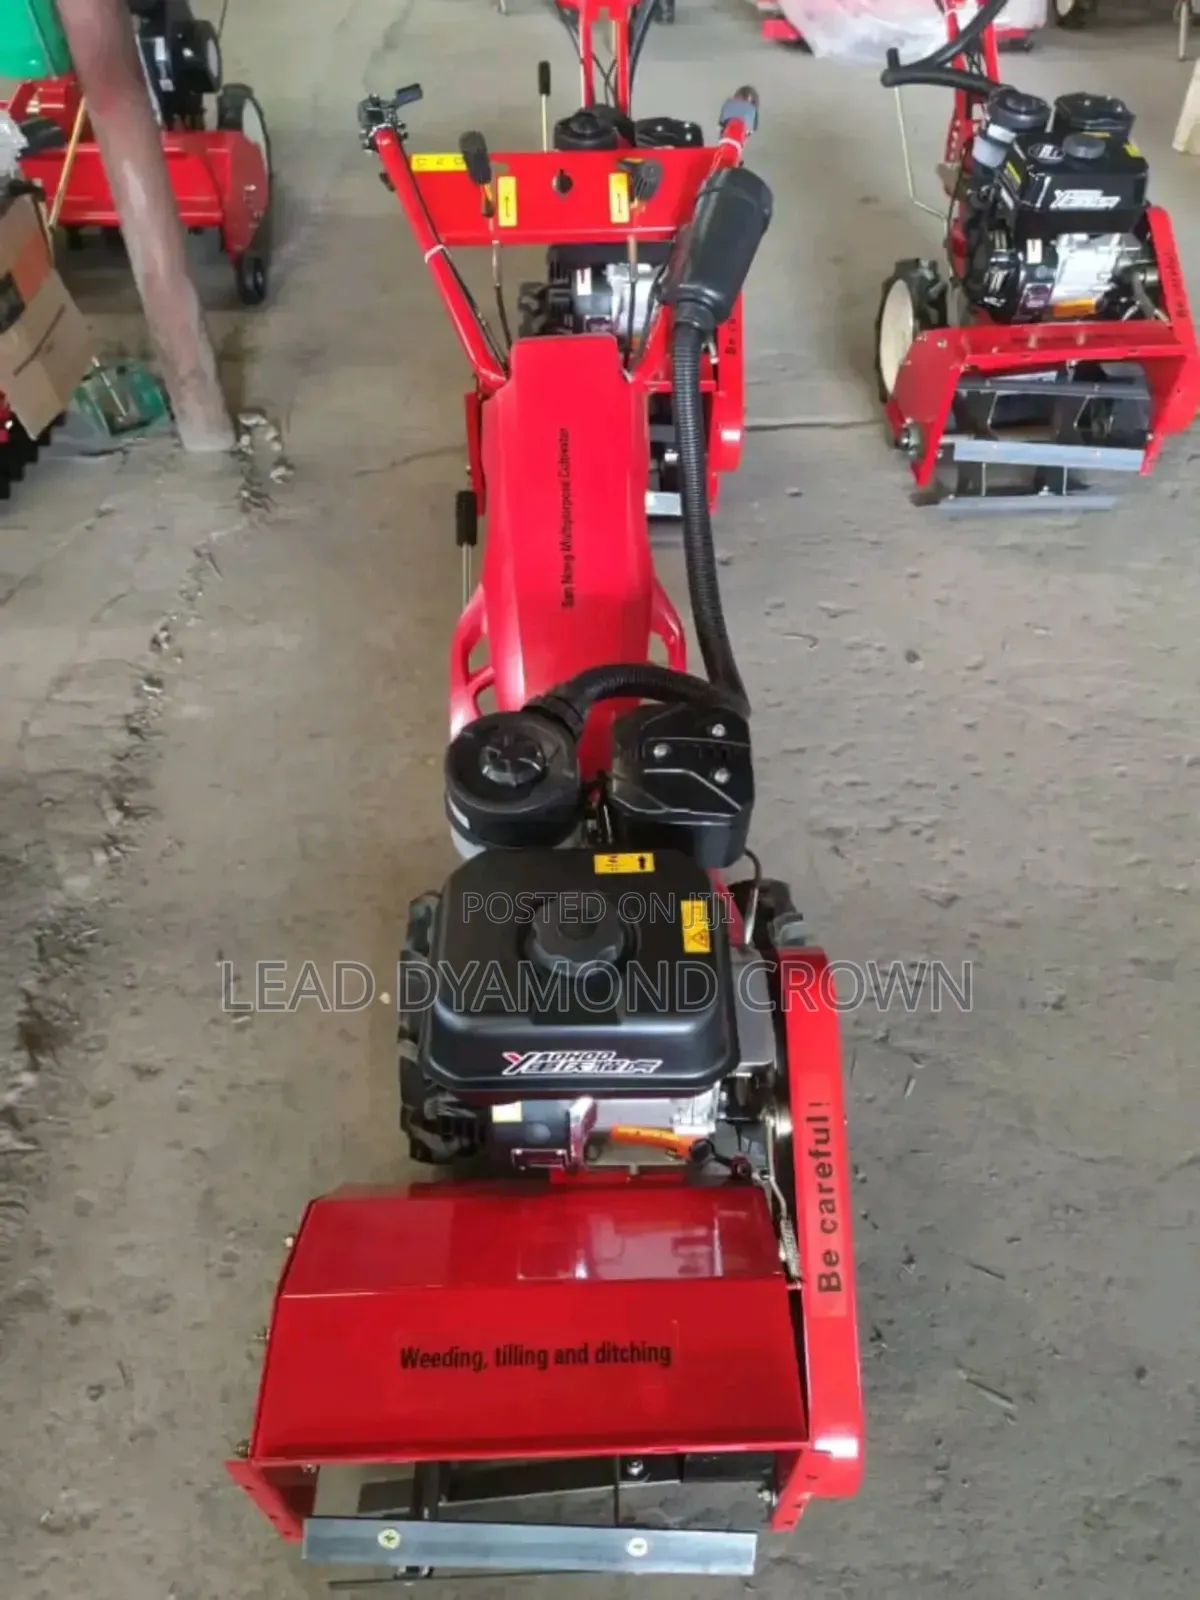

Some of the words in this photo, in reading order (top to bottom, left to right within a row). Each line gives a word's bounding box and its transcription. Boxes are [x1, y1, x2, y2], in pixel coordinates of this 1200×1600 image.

[805, 1101, 839, 1235] careful!
[817, 1249, 842, 1293] Be
[401, 1345, 488, 1372] Weeding,
[494, 1342, 548, 1371] tilling
[554, 1340, 589, 1366] and
[594, 1339, 672, 1367] ditching
